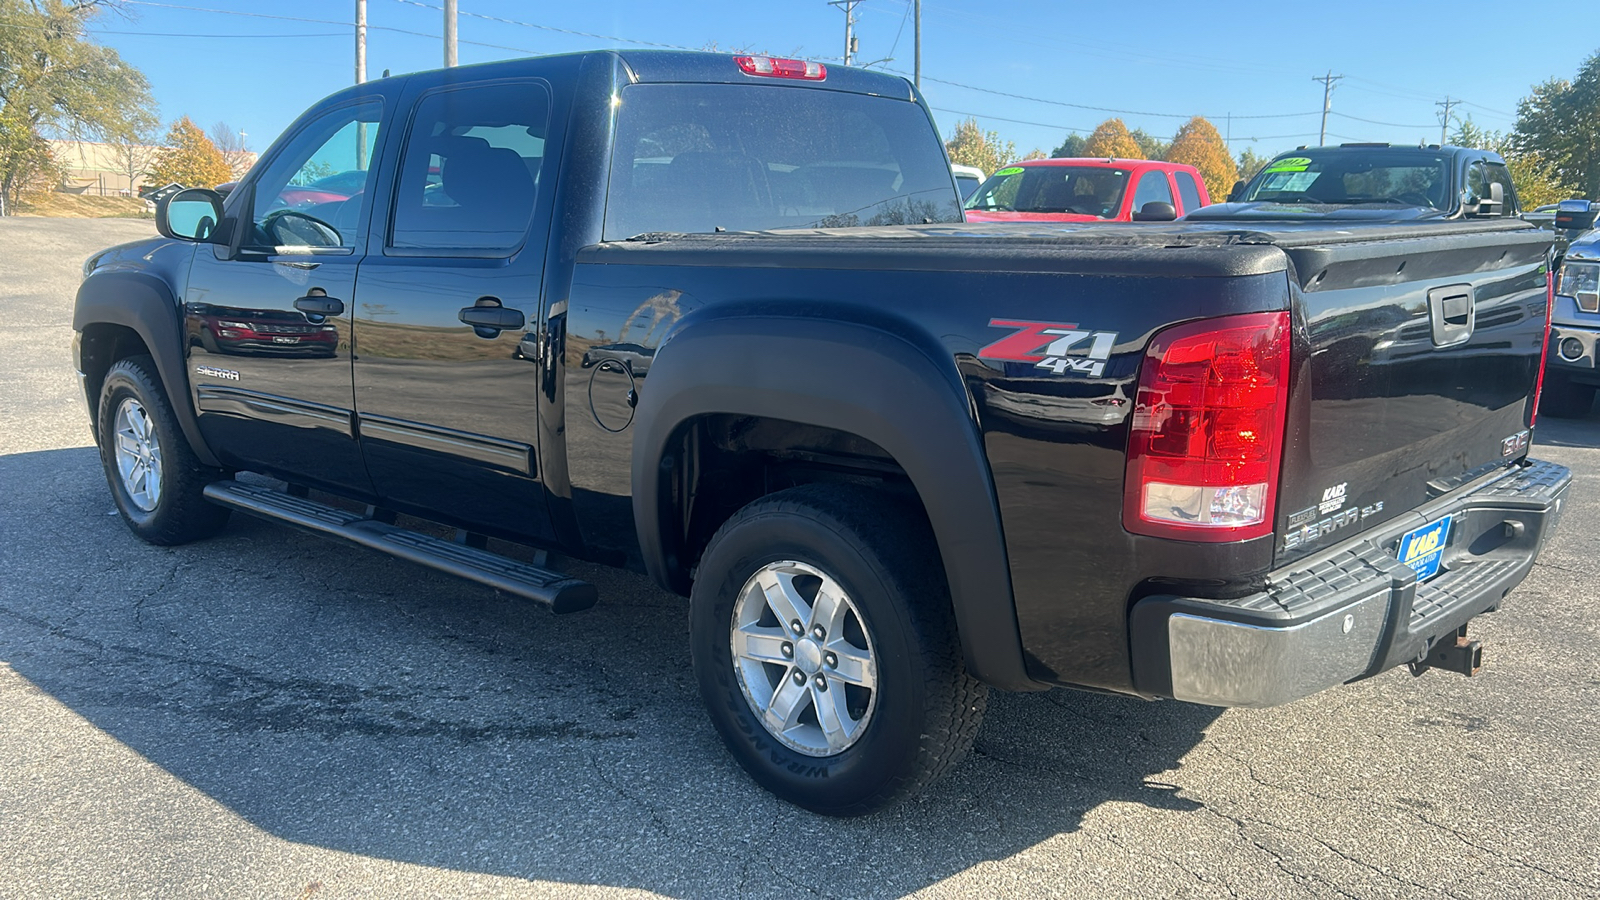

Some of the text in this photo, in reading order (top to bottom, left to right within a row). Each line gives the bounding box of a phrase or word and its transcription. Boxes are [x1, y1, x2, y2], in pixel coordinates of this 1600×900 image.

[977, 317, 1120, 362] Z71
[196, 365, 241, 381] SIERRA
[1283, 506, 1359, 551] SIERRA
